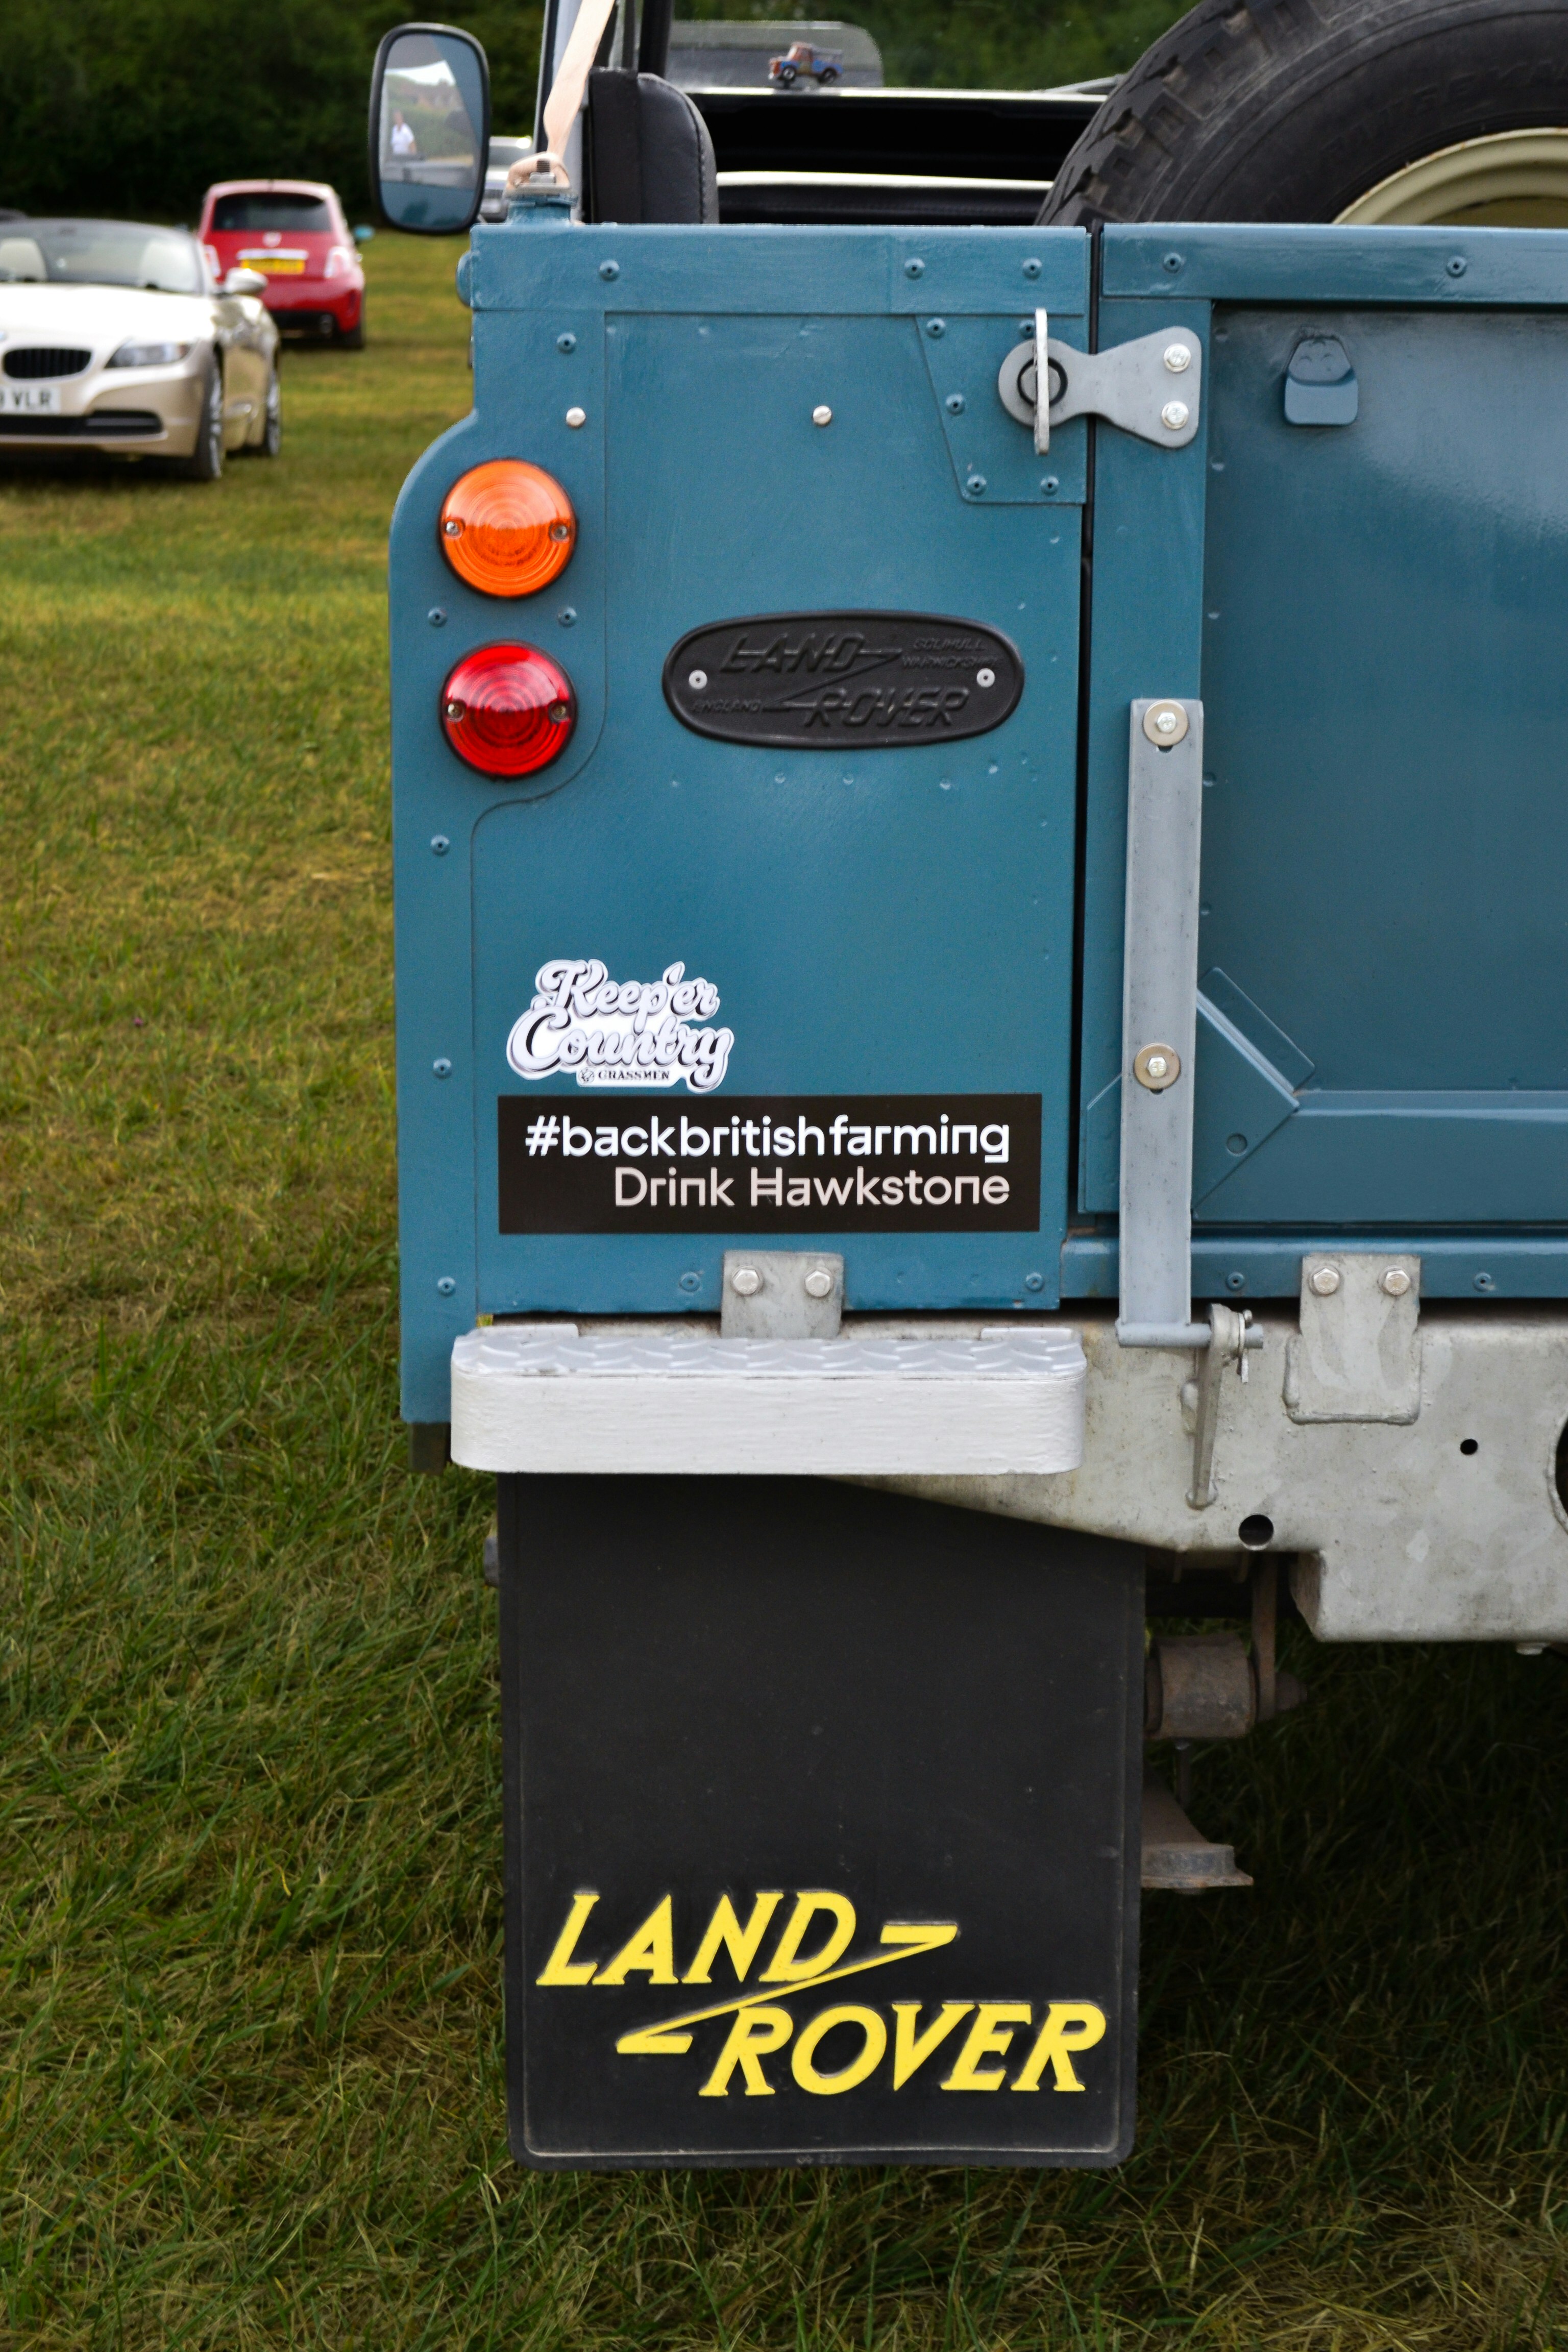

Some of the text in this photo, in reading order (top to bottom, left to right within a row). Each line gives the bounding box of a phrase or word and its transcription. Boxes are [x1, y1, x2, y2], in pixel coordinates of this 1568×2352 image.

[720, 632, 866, 673] LAND
[803, 686, 971, 728] ROVER
[537, 960, 719, 1035] Keep'er
[509, 996, 732, 1089] Country
[598, 1070, 670, 1082] GRASSMEN
[525, 1114, 1010, 1163] #backbritishfarming
[615, 1166, 1010, 1207] Drink Hawkstone
[535, 1891, 856, 1986] LAND
[698, 2002, 1107, 2097] ROVER
